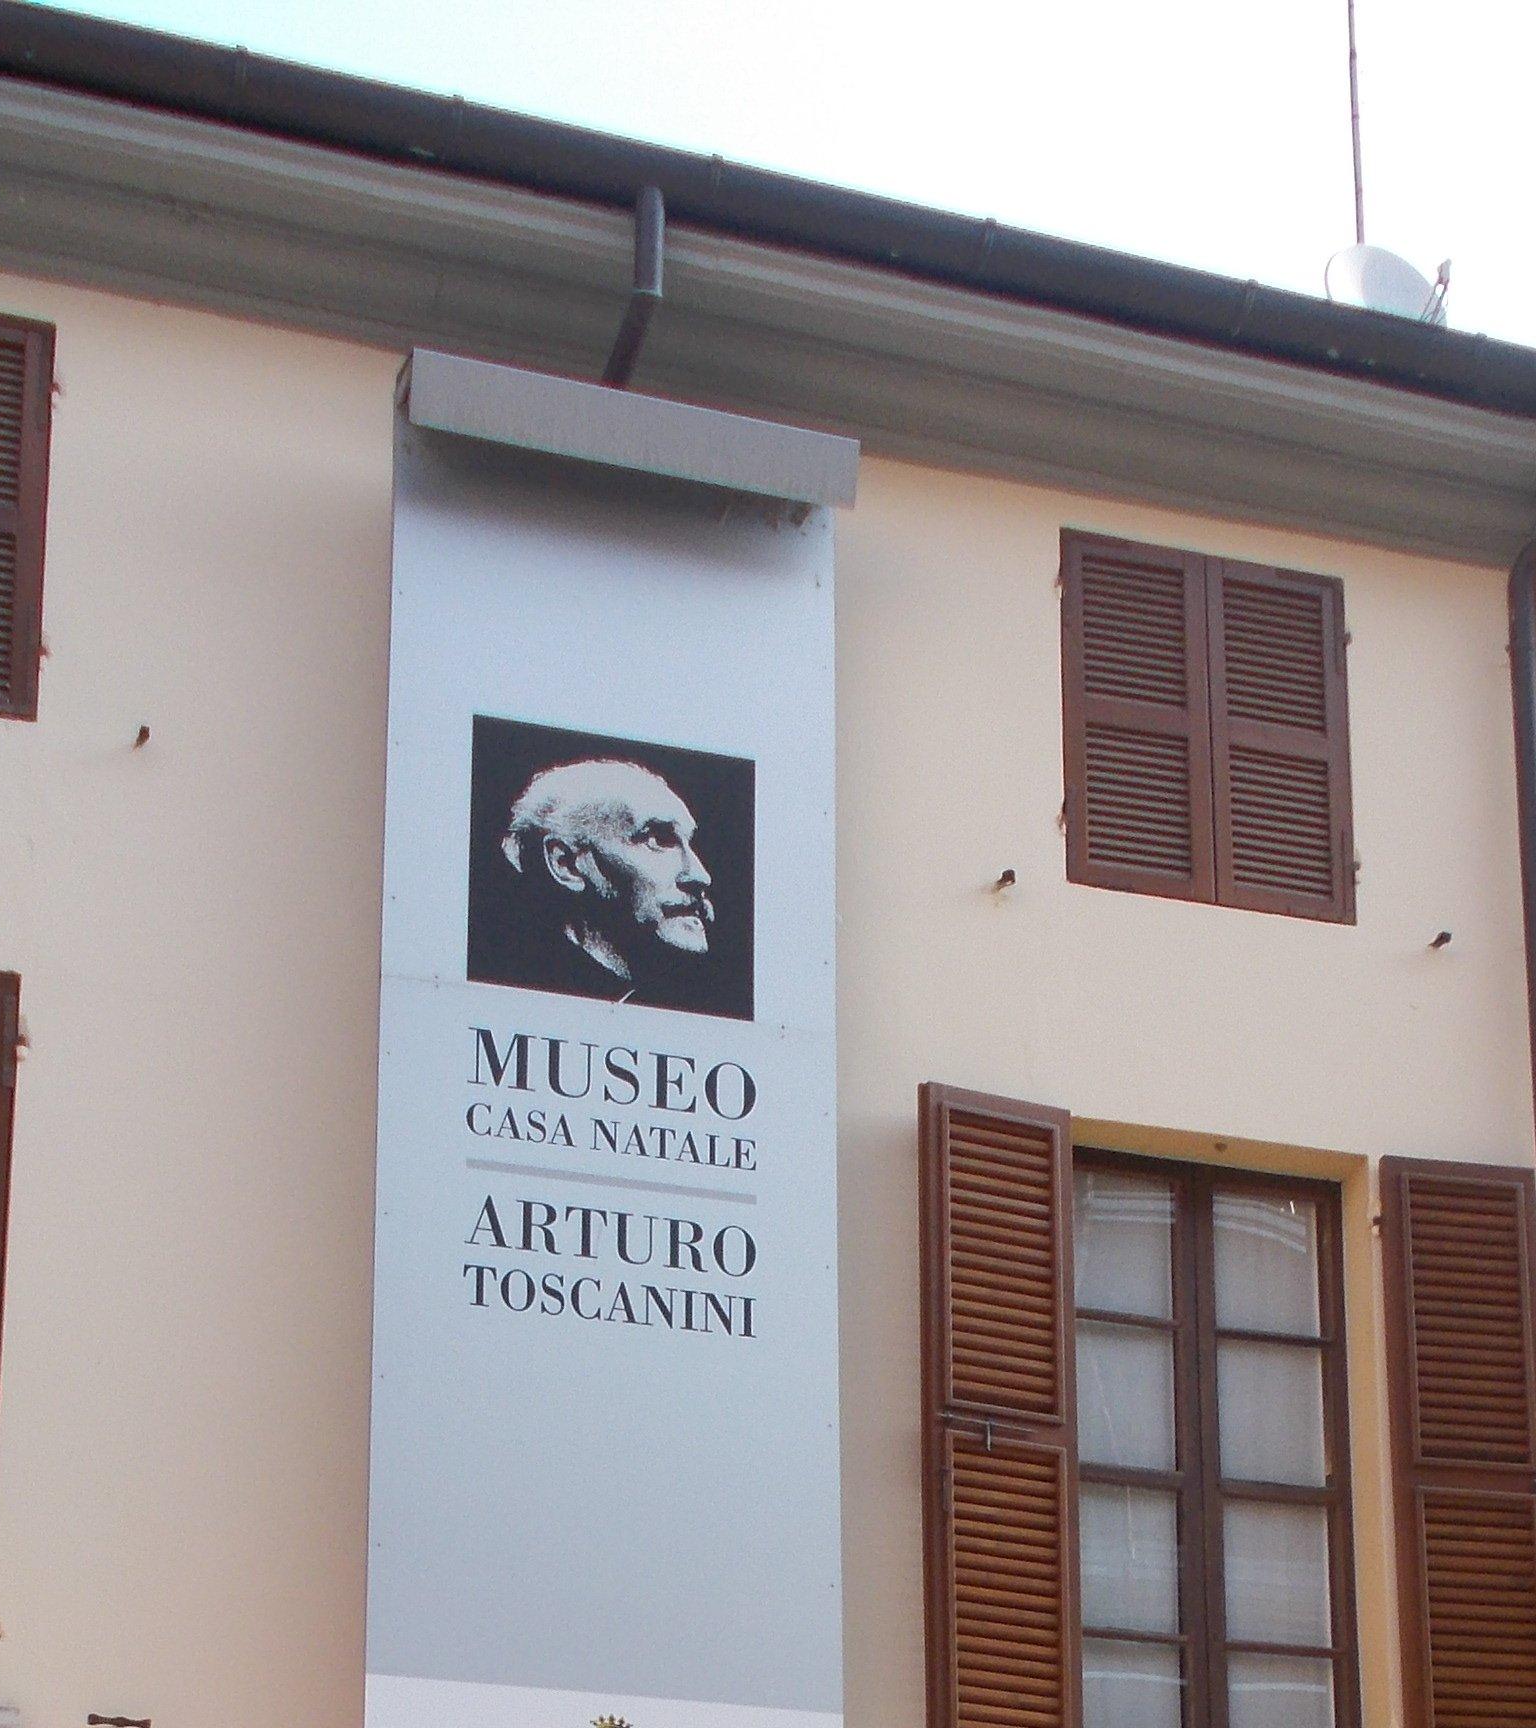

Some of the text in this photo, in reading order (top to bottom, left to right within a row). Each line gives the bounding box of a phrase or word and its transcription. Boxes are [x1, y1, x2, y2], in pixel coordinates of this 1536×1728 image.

[467, 1026, 758, 1121] MUSEO
[465, 1102, 758, 1171] CASA NATALE
[463, 1195, 757, 1277] ARTURO
[463, 1263, 758, 1339] TOSCANINI
